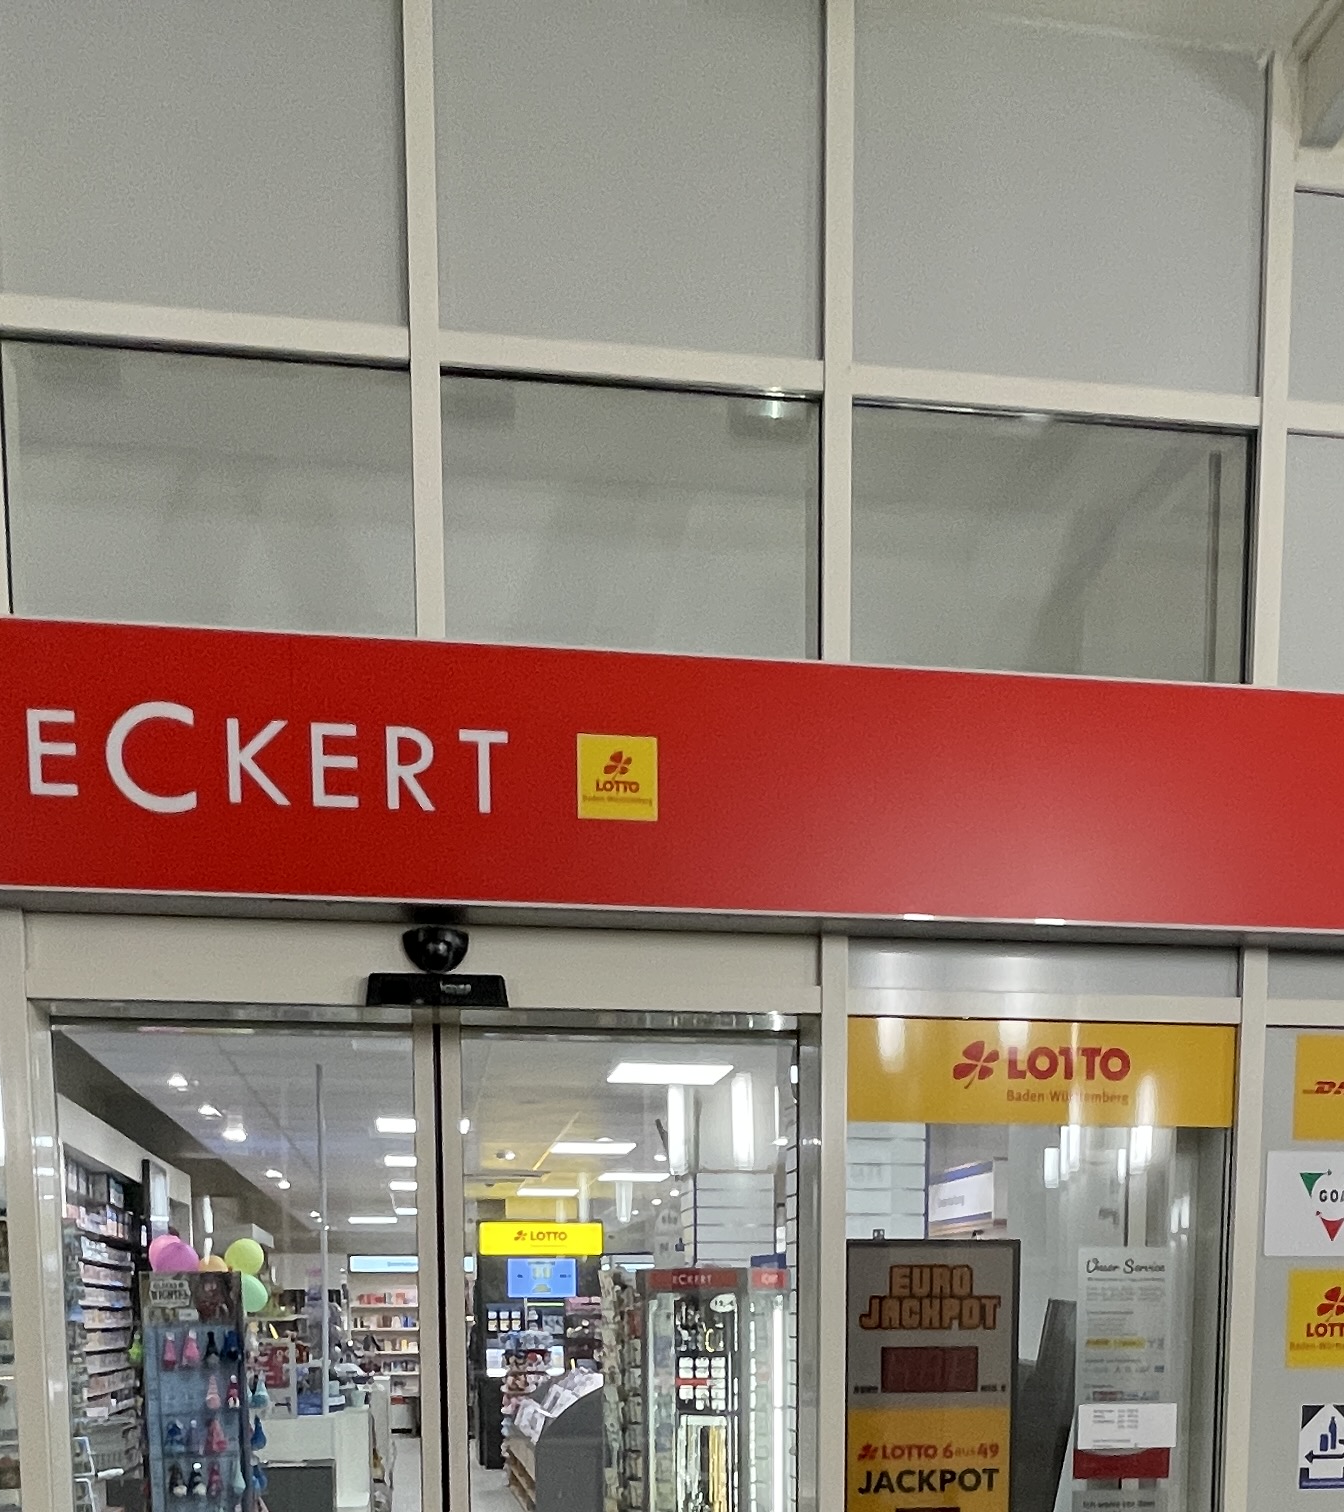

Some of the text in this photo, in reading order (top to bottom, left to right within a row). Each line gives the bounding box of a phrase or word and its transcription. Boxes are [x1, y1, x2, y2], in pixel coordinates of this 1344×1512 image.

[26, 700, 510, 816] ECKERT
[595, 779, 640, 793] LOTTO
[1008, 1046, 1131, 1082] LOTTO
[530, 1231, 567, 1241] LOTTO
[890, 1264, 973, 1297] EURO
[859, 1295, 1001, 1330] JACKPOT
[881, 1443, 939, 1461] LOTTO
[858, 1468, 1000, 1494] JACKPOT
